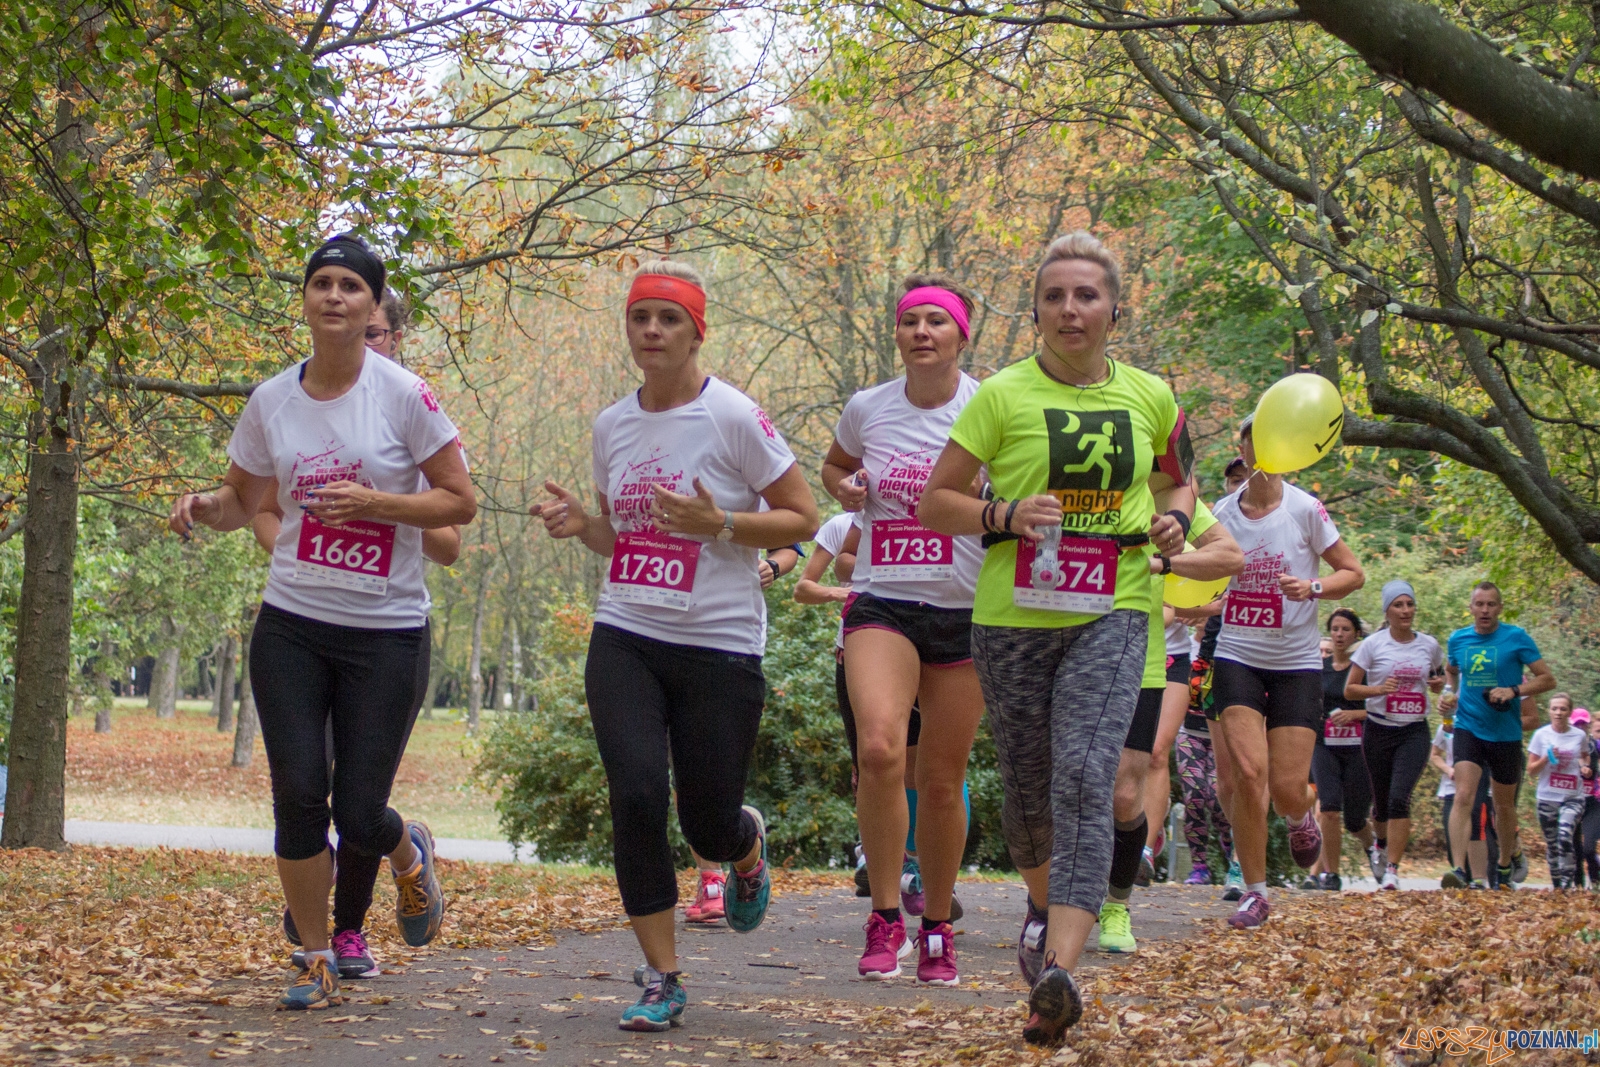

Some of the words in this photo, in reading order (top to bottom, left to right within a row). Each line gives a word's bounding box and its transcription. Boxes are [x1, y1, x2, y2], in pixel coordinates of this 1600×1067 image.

[889, 467, 931, 480] zaws
[882, 491, 902, 500] 2016
[1063, 491, 1115, 511] night
[1063, 510, 1120, 527] nners
[309, 534, 382, 572] 1662
[881, 538, 943, 562] 1733
[619, 554, 684, 586] 1730
[1244, 560, 1281, 572] awsze
[1230, 605, 1275, 626] 1473
[1390, 701, 1422, 713] 1486
[1328, 726, 1358, 737] 1771
[1552, 779, 1574, 789] 1471
